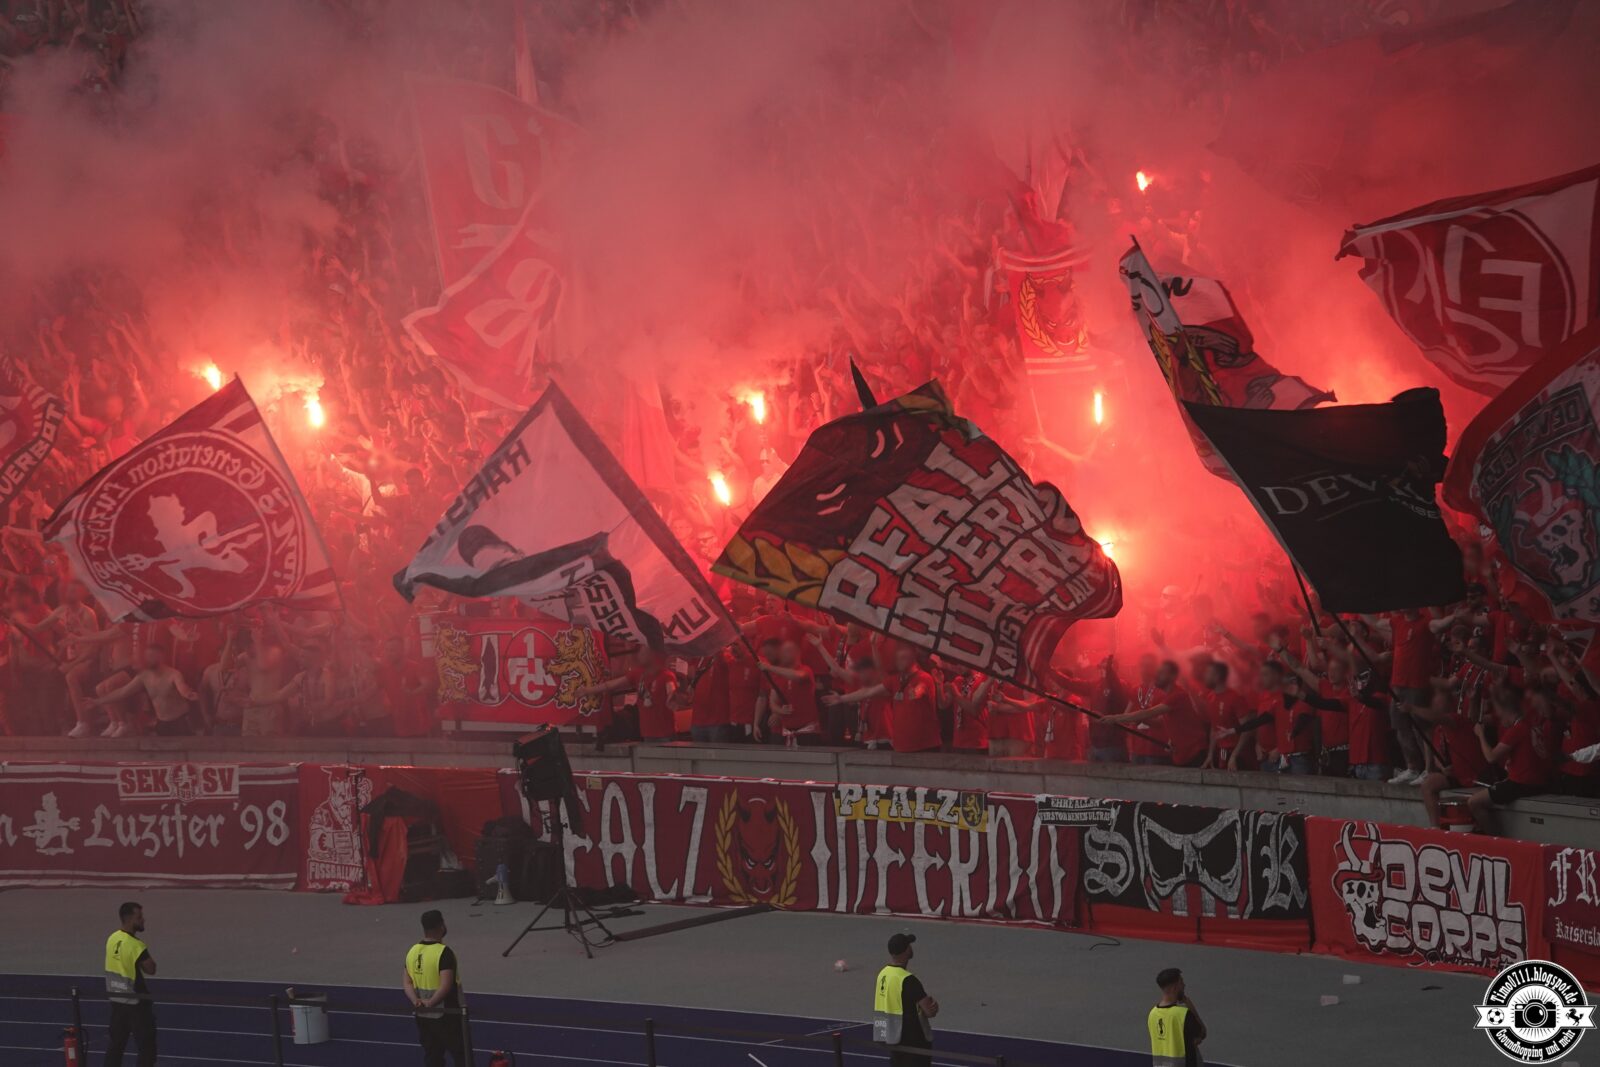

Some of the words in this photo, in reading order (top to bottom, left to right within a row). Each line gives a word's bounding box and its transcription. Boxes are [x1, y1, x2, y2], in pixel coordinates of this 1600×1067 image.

[818, 441, 1021, 631] PFAL
[937, 527, 1097, 667] ULTRA
[120, 768, 169, 794] SEK
[203, 766, 235, 793] SV
[838, 783, 960, 825] PFALZ
[83, 803, 225, 859] Luzifer
